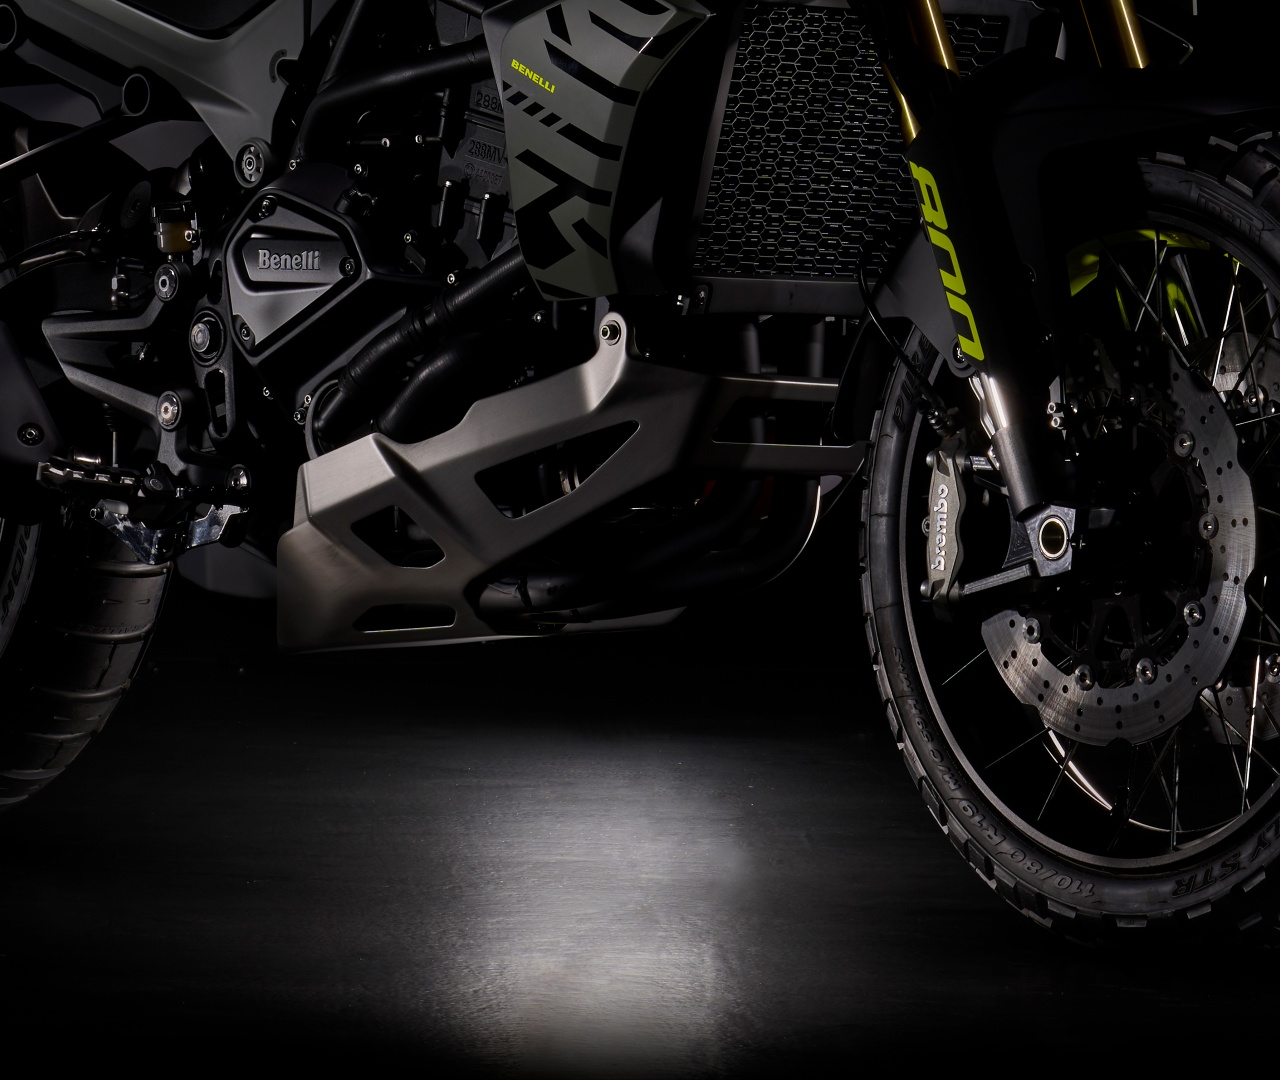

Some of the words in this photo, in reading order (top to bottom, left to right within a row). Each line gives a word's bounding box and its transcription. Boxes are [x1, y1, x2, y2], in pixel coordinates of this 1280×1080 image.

[510, 58, 556, 94] BENELLI
[257, 249, 321, 271] Benelli
[930, 483, 949, 571] brembo
[959, 798, 1006, 848] R19
[1007, 846, 1095, 898] 110/80
[1171, 851, 1241, 899] STR
